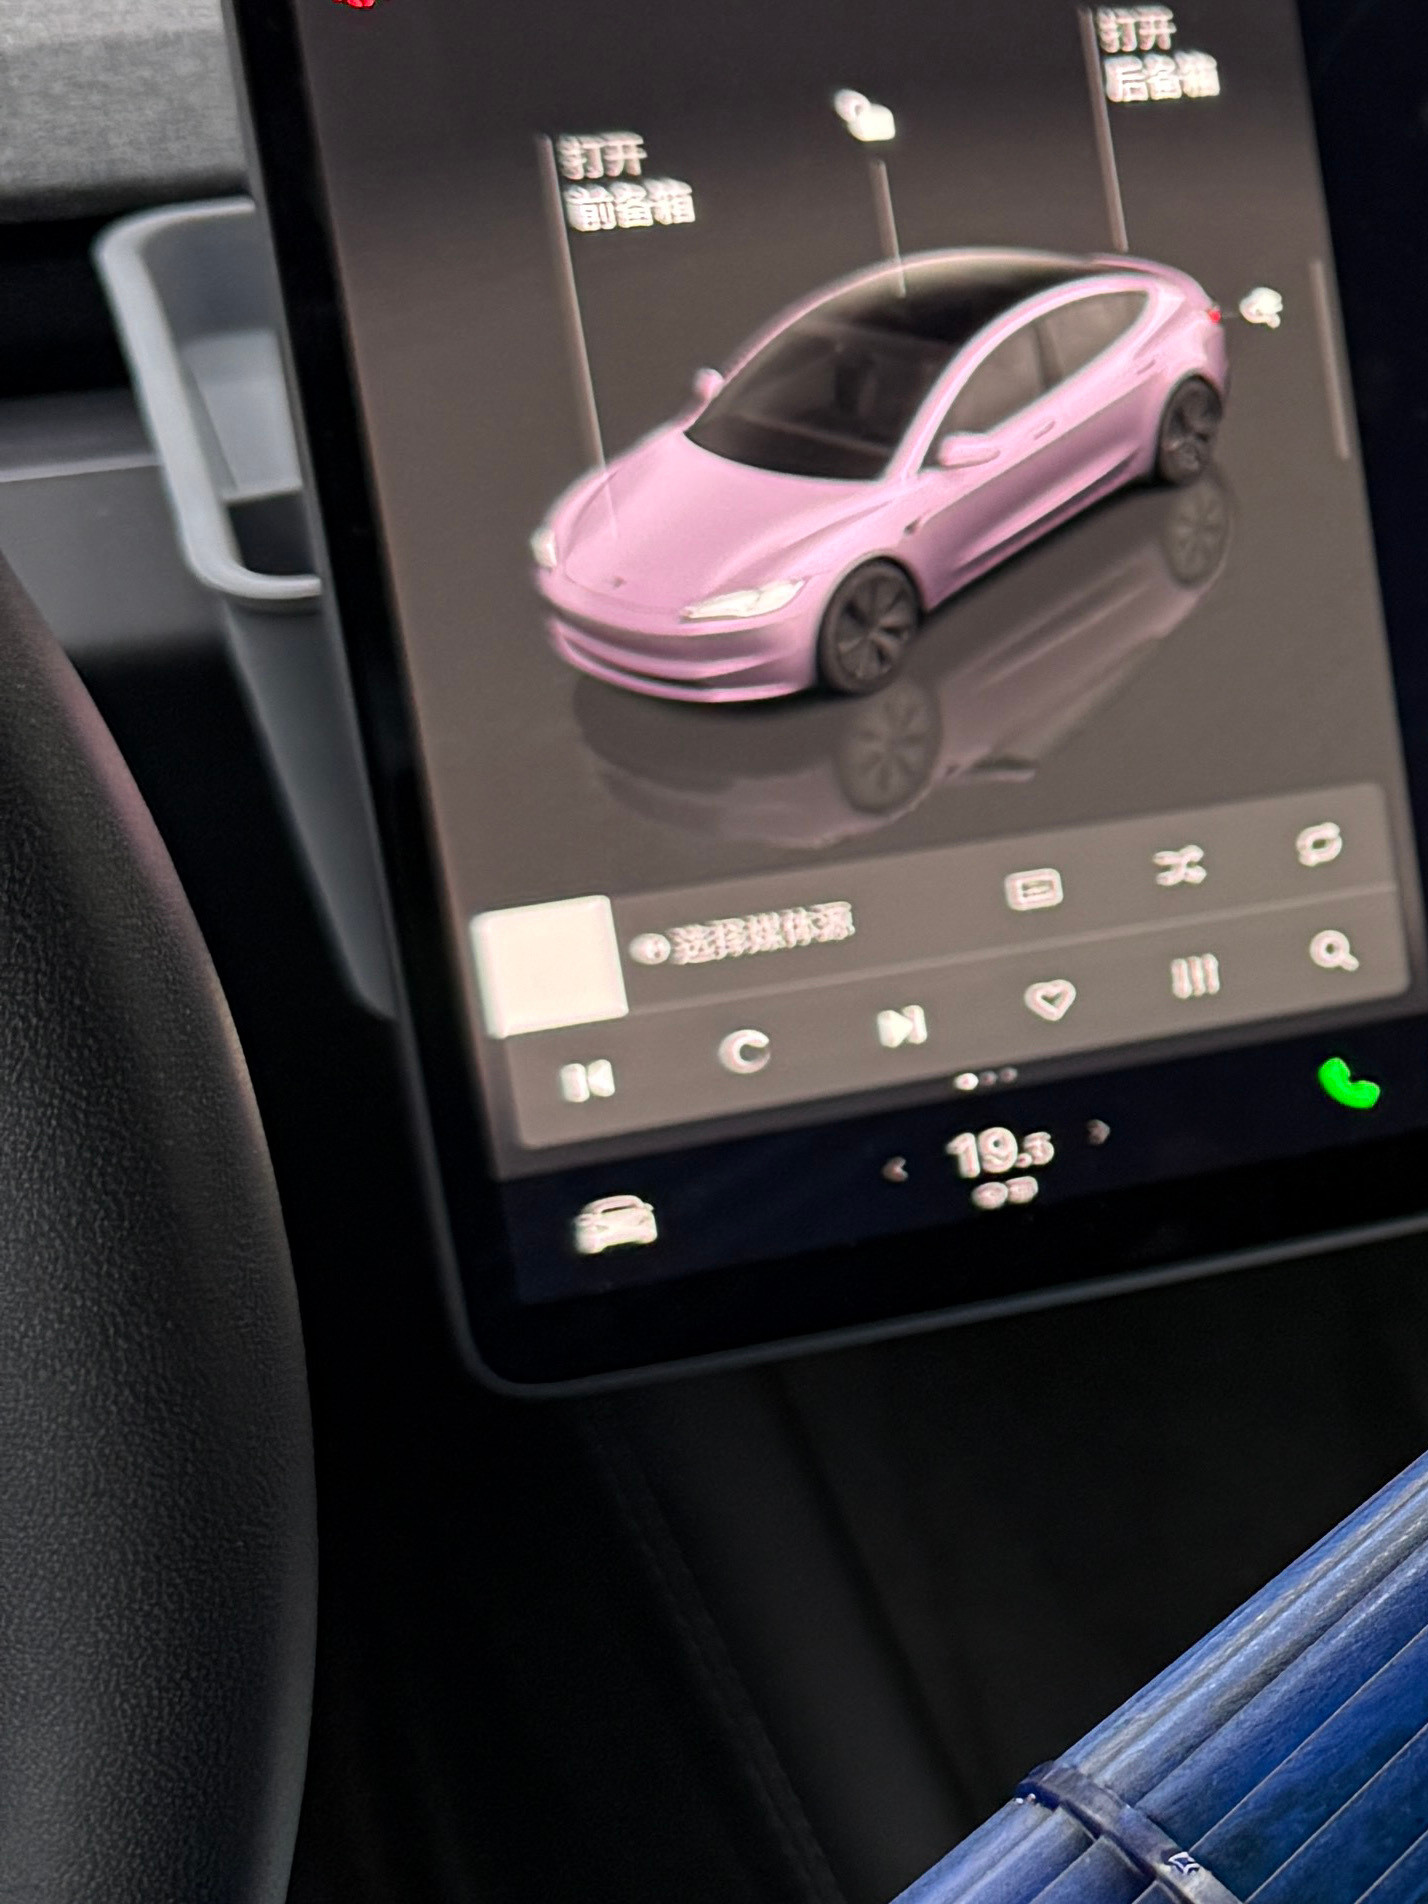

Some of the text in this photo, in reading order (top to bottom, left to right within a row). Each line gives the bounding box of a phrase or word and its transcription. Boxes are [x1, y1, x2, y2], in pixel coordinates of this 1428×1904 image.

[1096, 4, 1177, 53] 打开
[558, 130, 648, 180] 打开
[563, 176, 697, 232] 前备箱
[946, 1126, 1055, 1179] 19.5
